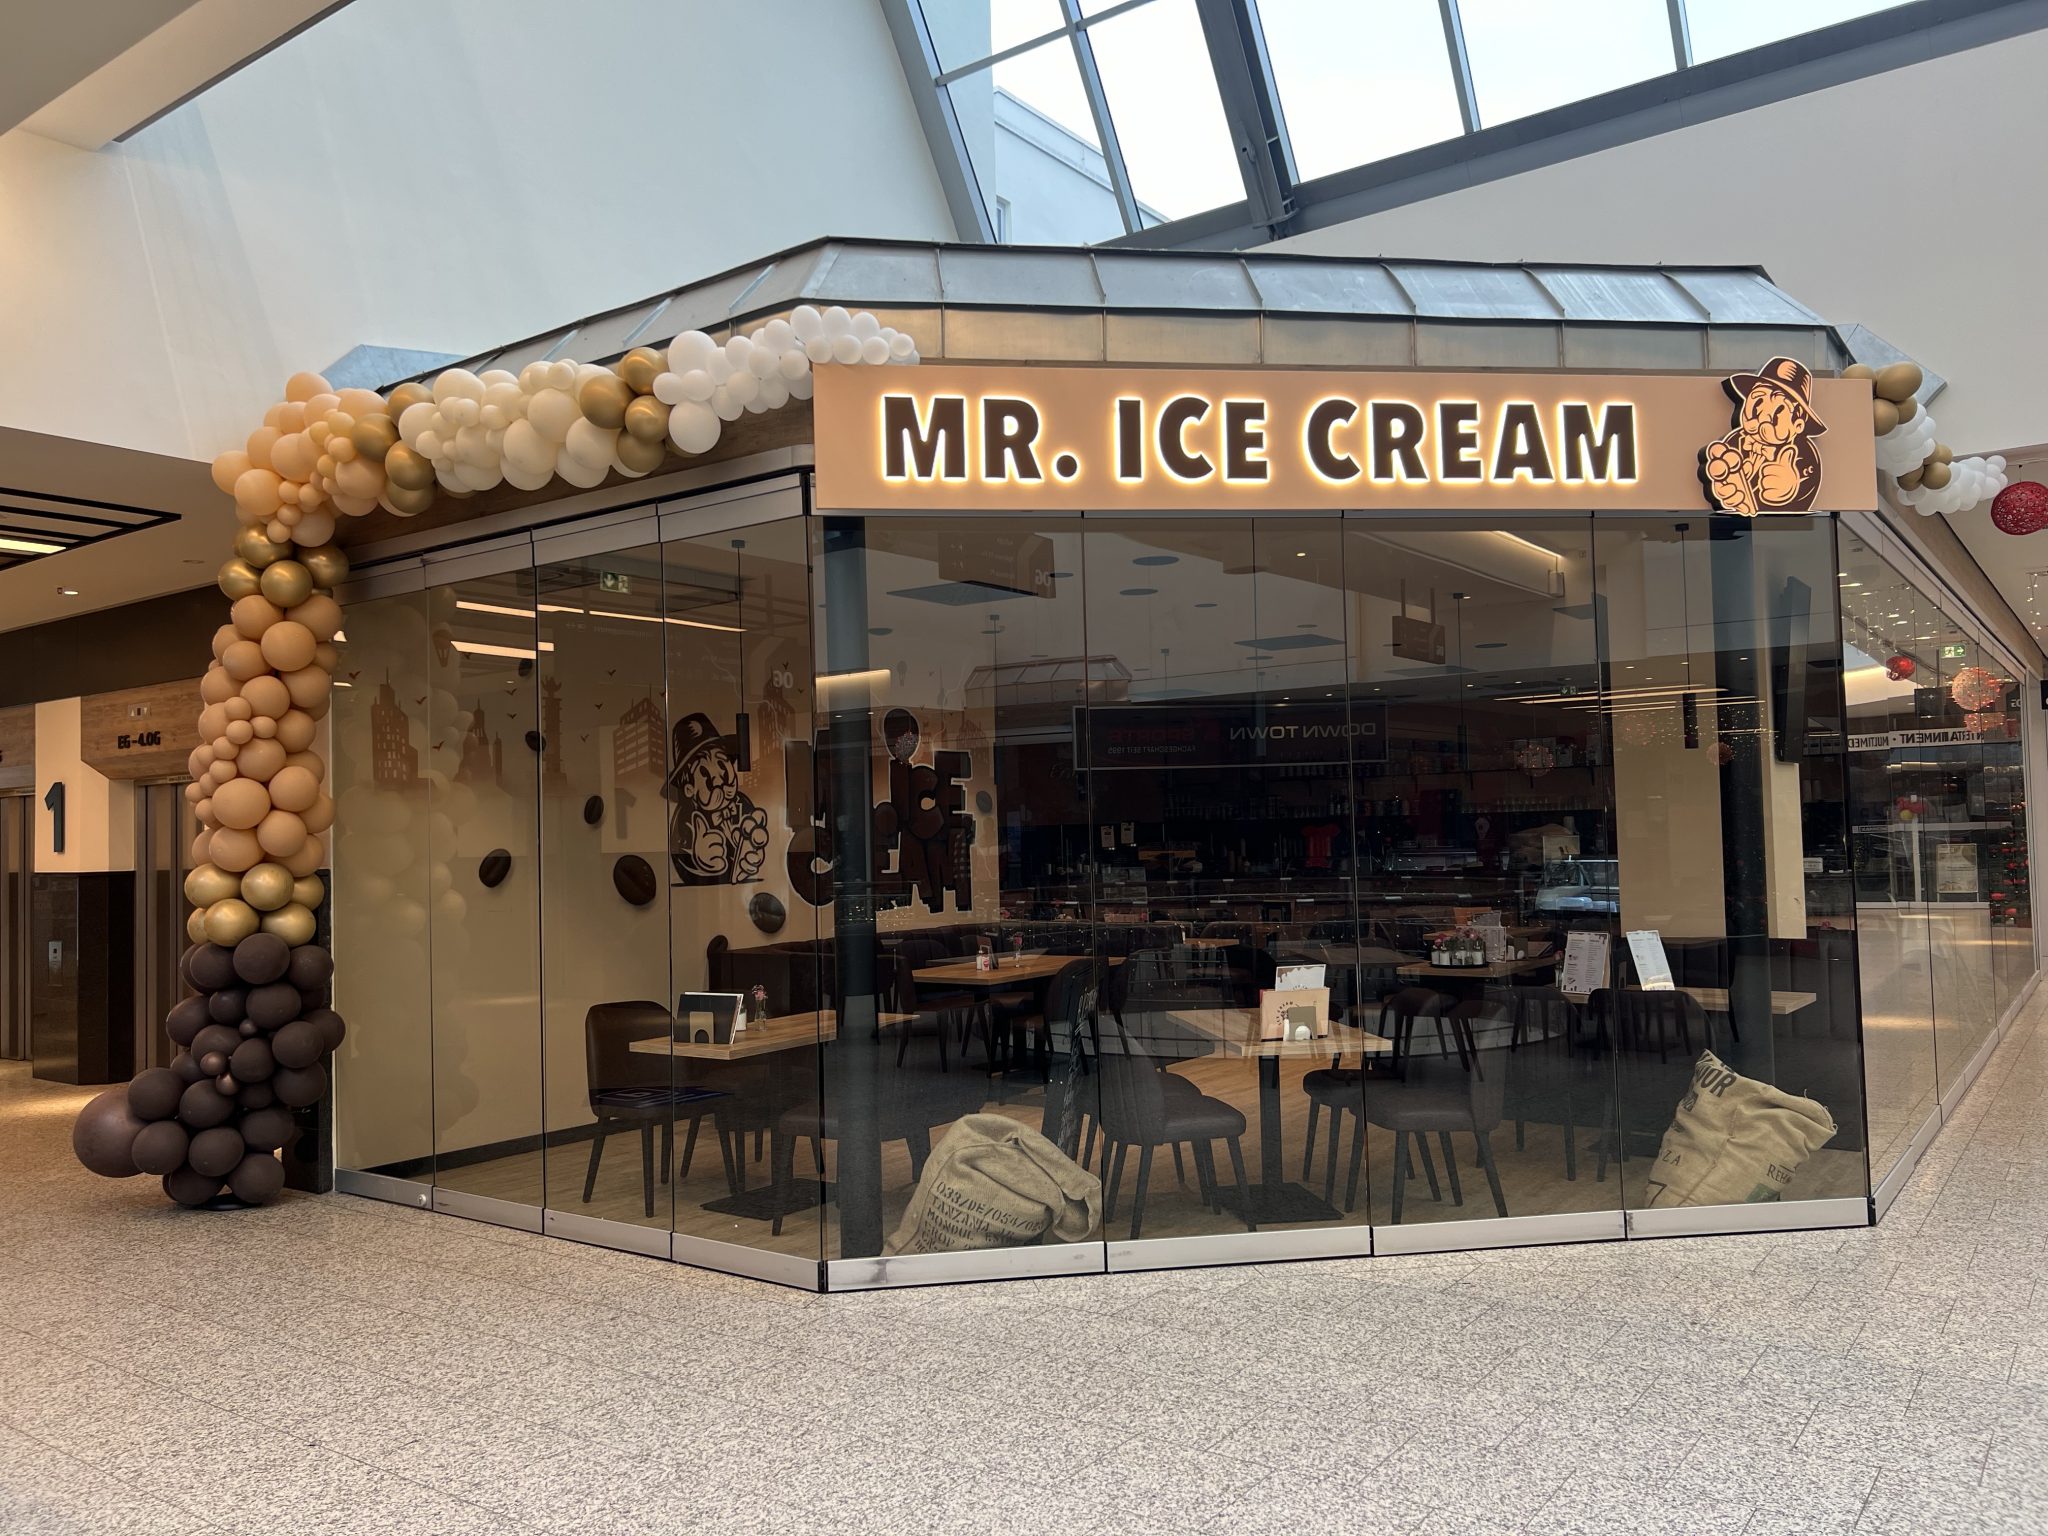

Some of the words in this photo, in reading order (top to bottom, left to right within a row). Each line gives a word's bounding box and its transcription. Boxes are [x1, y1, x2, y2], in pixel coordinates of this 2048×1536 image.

[883, 396, 1079, 479] MR.
[1117, 396, 1269, 480] ICE
[1307, 398, 1637, 481] CREAM
[44, 781, 64, 853] 1
